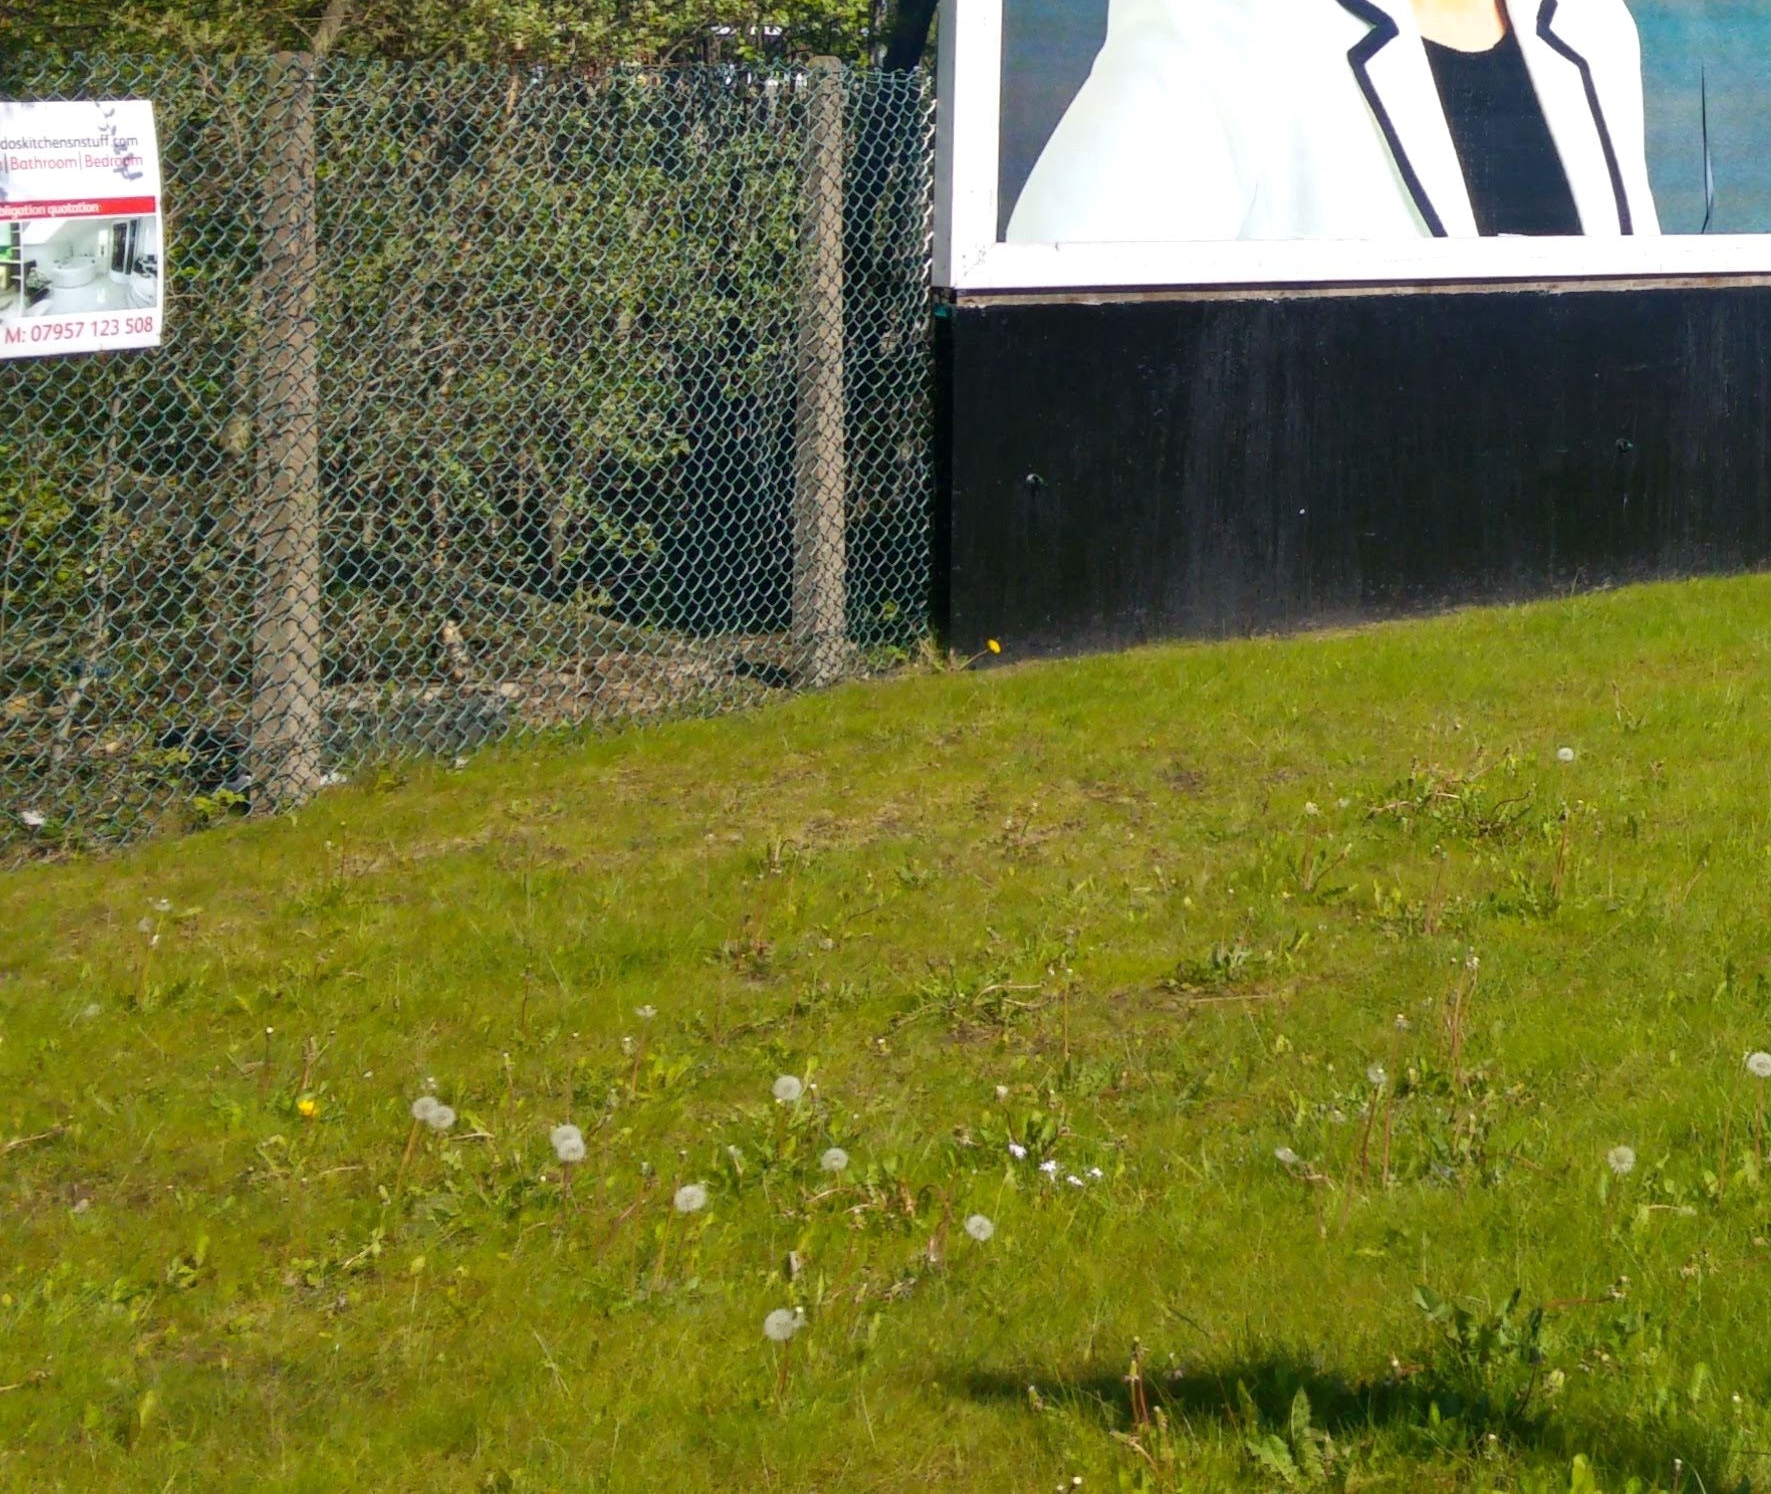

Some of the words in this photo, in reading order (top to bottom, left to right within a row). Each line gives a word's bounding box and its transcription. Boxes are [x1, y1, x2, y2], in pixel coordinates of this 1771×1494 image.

[10, 156, 77, 170] Bathroom
[85, 154, 143, 168] Bedroom
[47, 202, 100, 217] quotation
[5, 327, 26, 344] M:
[31, 322, 84, 342] 07957
[91, 319, 119, 337] 123
[125, 316, 153, 334] 508
